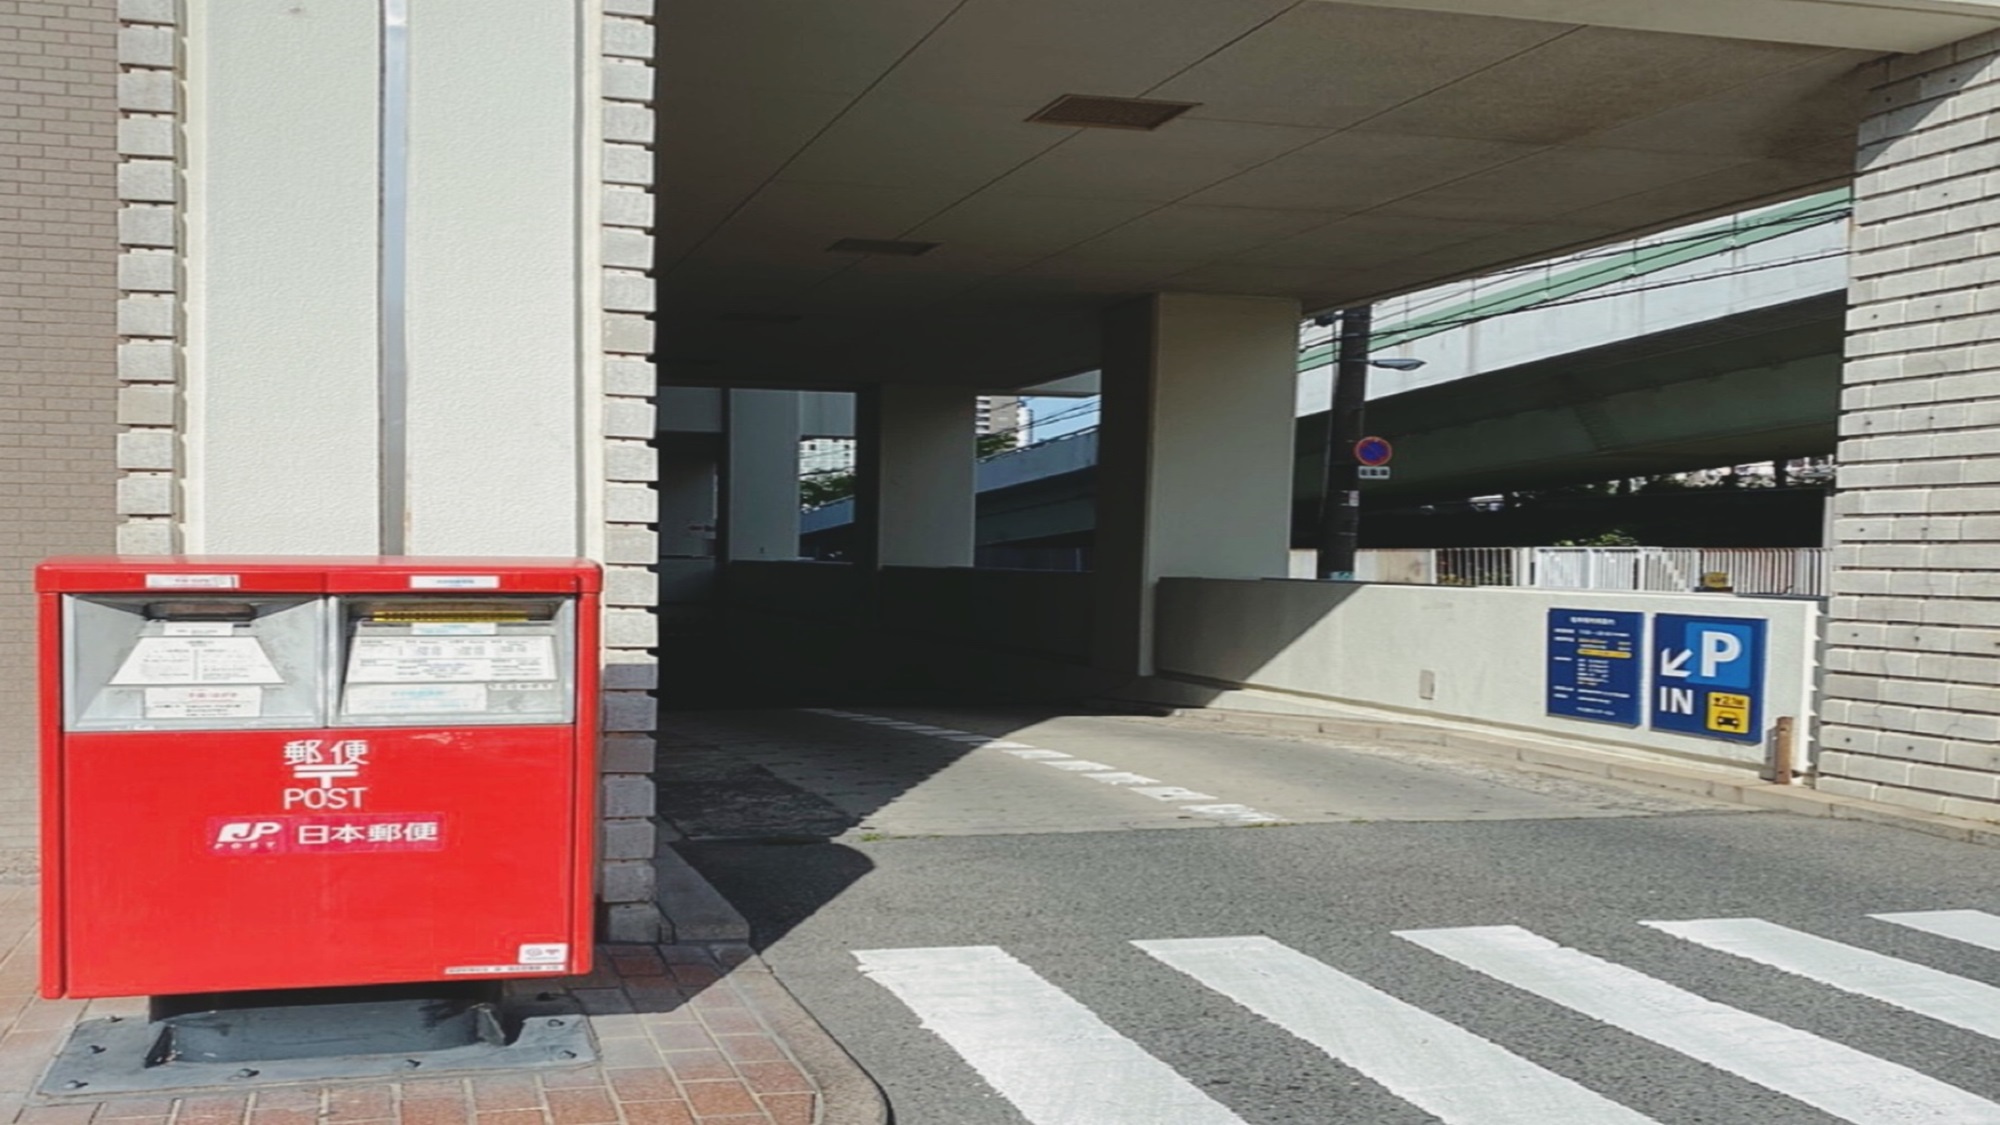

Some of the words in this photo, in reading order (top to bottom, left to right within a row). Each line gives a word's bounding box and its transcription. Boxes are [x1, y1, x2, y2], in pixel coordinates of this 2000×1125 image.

[1701, 630, 1742, 677] P
[1660, 686, 1694, 715] IN
[283, 739, 369, 765] 郵便
[284, 787, 368, 810] POST
[298, 822, 438, 845] 日本郵便
